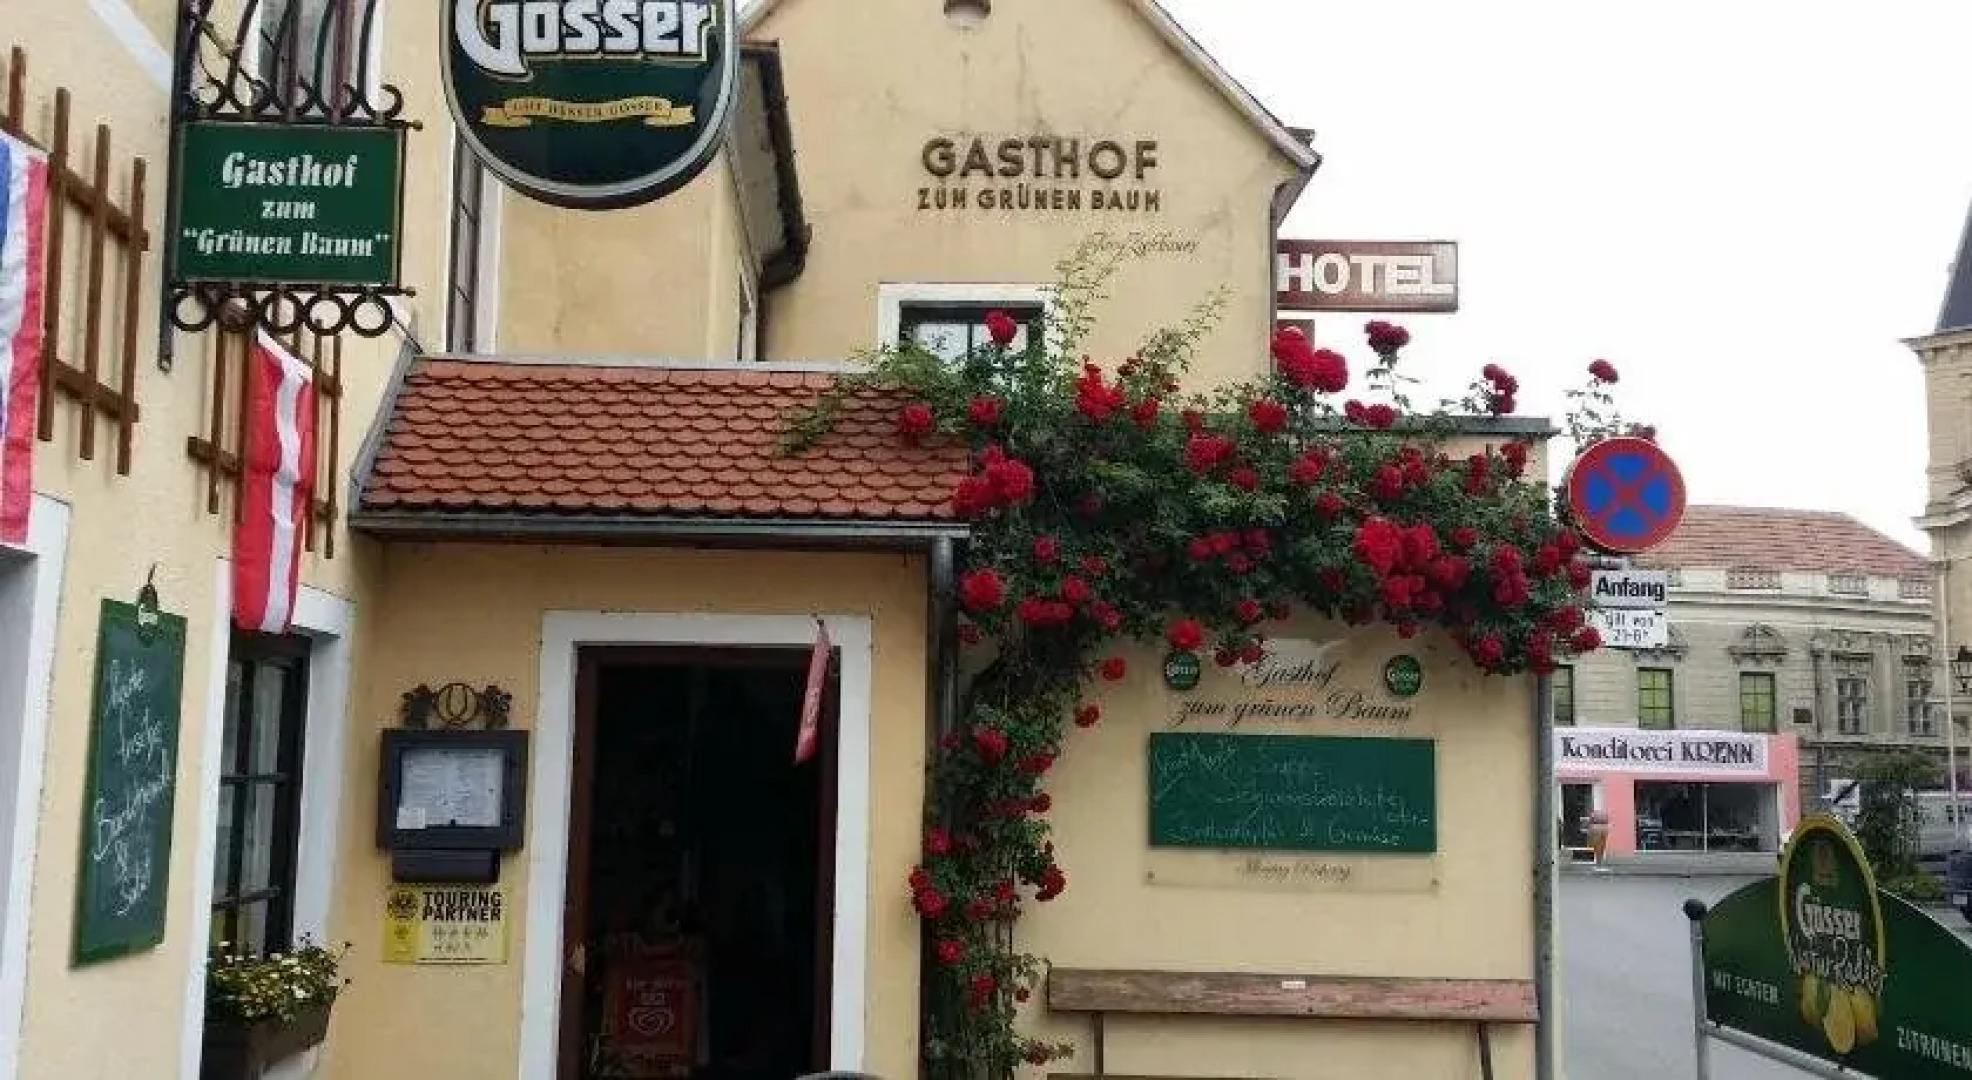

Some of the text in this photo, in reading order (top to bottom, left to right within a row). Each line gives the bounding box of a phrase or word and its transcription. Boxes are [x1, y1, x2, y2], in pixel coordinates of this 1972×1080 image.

[222, 152, 358, 188] Gasthof
[922, 137, 1159, 179] GASTHOF
[261, 201, 316, 219] zum
[917, 183, 1161, 212] ZUM GRÜNEN BAUM
[1277, 252, 1454, 295] HOTEL
[1596, 575, 1665, 601] Anfang
[1242, 653, 1340, 688] Gasthof
[1167, 693, 1413, 727] zum grünen Baum
[1561, 736, 1754, 764] Konditorei KRENN
[422, 891, 502, 906] TOURING
[422, 906, 501, 921] PARTNER
[1713, 969, 1778, 1003] MIT ECHTEN
